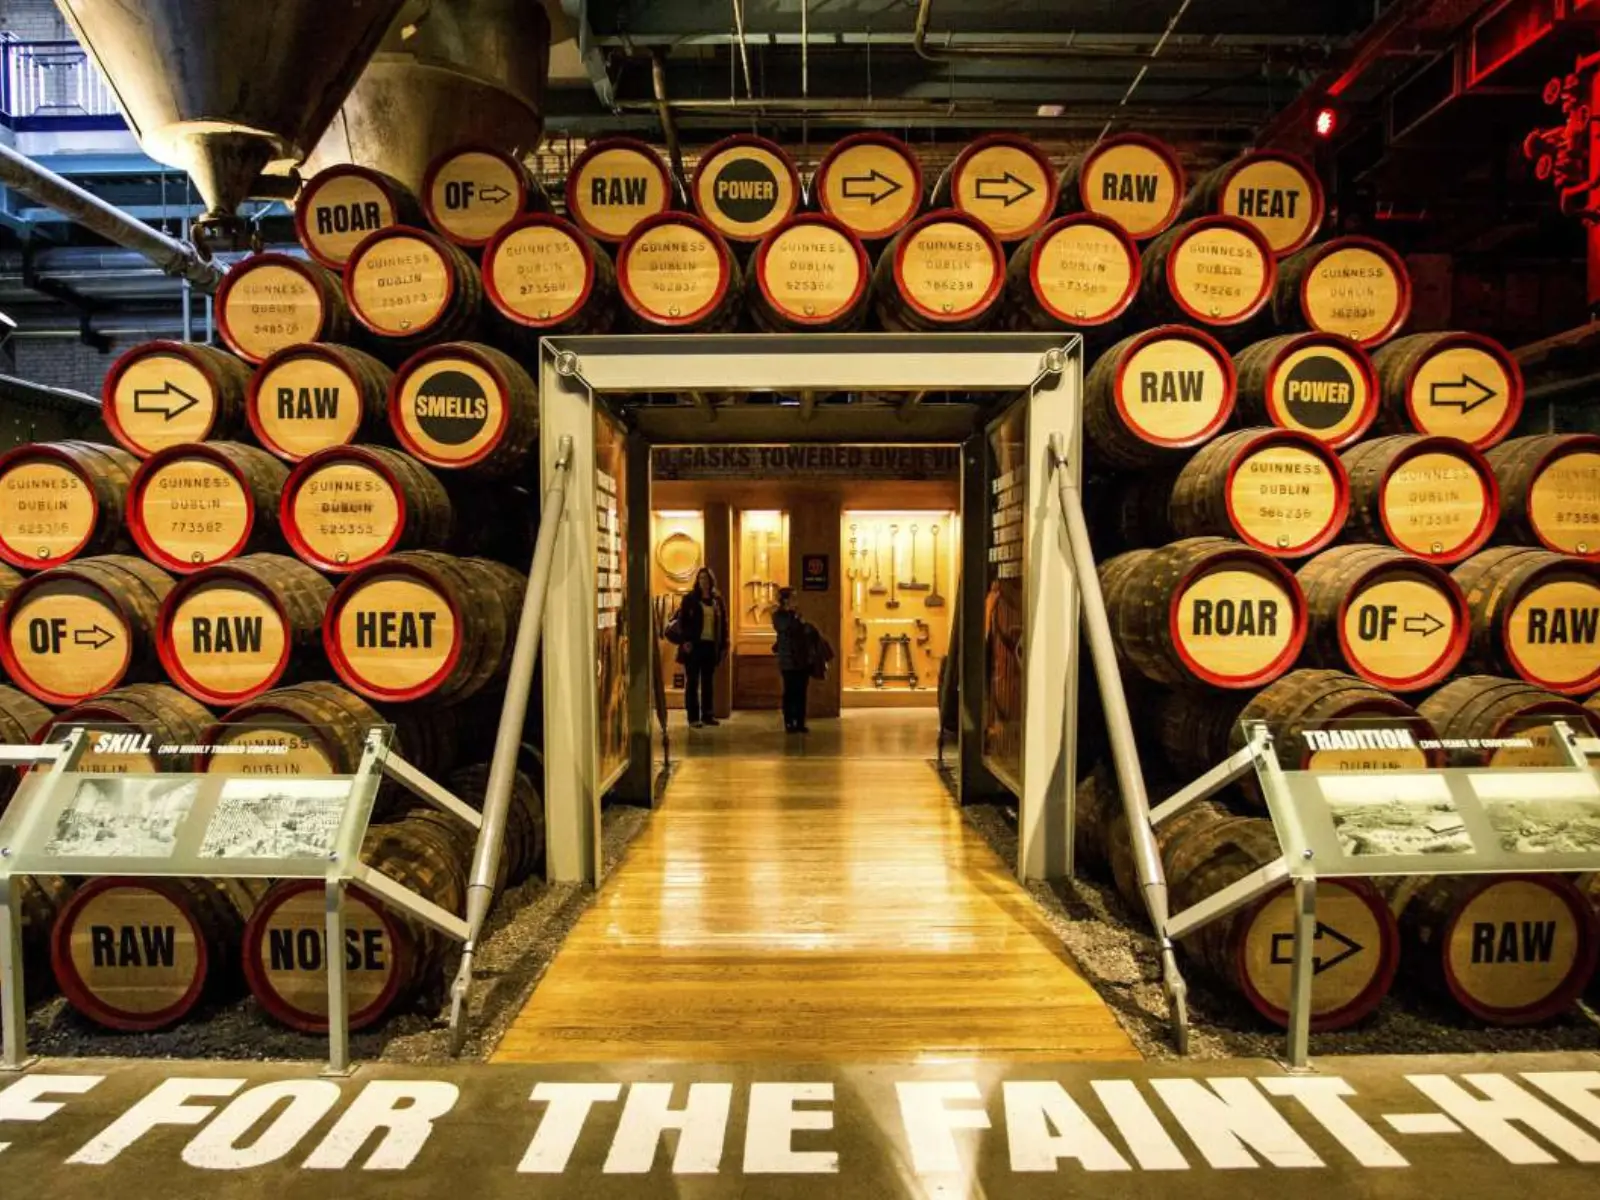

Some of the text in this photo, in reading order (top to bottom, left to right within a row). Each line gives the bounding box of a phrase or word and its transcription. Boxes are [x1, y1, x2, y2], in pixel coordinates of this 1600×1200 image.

[445, 181, 475, 210] OF
[591, 177, 648, 206] RAW
[717, 179, 775, 202] POWER
[1102, 173, 1159, 204] RAW
[1238, 188, 1300, 220] HEAT
[316, 202, 380, 235] ROAR
[506, 242, 570, 258] GUINNESS
[641, 242, 705, 253] GUINNESS
[779, 242, 846, 254] GUINNESS
[917, 240, 982, 252] GUINNESS
[1189, 243, 1253, 259] GUINNESS
[366, 254, 430, 270] GUINNESS
[517, 263, 563, 275] DUBLIN
[650, 260, 697, 271] DUBLIN
[789, 260, 835, 272] DUBLIN
[925, 259, 971, 270] DUBLIN
[1060, 259, 1106, 273] DUBLIN
[1196, 263, 1242, 276] DUBLIN
[377, 273, 422, 288] DUBLIN
[1321, 267, 1385, 278] GUINNESS
[243, 283, 306, 296] GUINNESS
[251, 304, 296, 314] DUBLIN
[1140, 370, 1204, 403] RAW
[1288, 380, 1349, 404] POWER
[277, 387, 339, 419] RAW
[416, 395, 487, 419] SMELLS
[1250, 462, 1321, 475] GUINNESS
[1399, 468, 1469, 481] GUINNESS
[7, 478, 78, 490] GUINNESS
[158, 477, 230, 489] GUINNESS
[310, 480, 383, 493] GUINNESS
[1260, 484, 1310, 496] DUBLIN
[18, 499, 68, 510] DUBLIN
[171, 498, 221, 510] DUBLIN
[1408, 491, 1460, 503] DUBLIN
[321, 502, 375, 513] DUBLIN
[1192, 599, 1277, 637] ROAR
[1358, 604, 1397, 642] OF
[1527, 607, 1600, 645] RAW
[29, 617, 67, 654] OF
[192, 616, 263, 653] RAW
[355, 611, 436, 649] HEAT
[94, 733, 152, 753] SKILL
[1301, 728, 1416, 751] TRADITION
[91, 925, 175, 967] RAW
[269, 928, 385, 971] NOSE
[1470, 920, 1557, 964] RAW
[63, 1077, 460, 1170] FOR
[516, 1082, 840, 1174] THE
